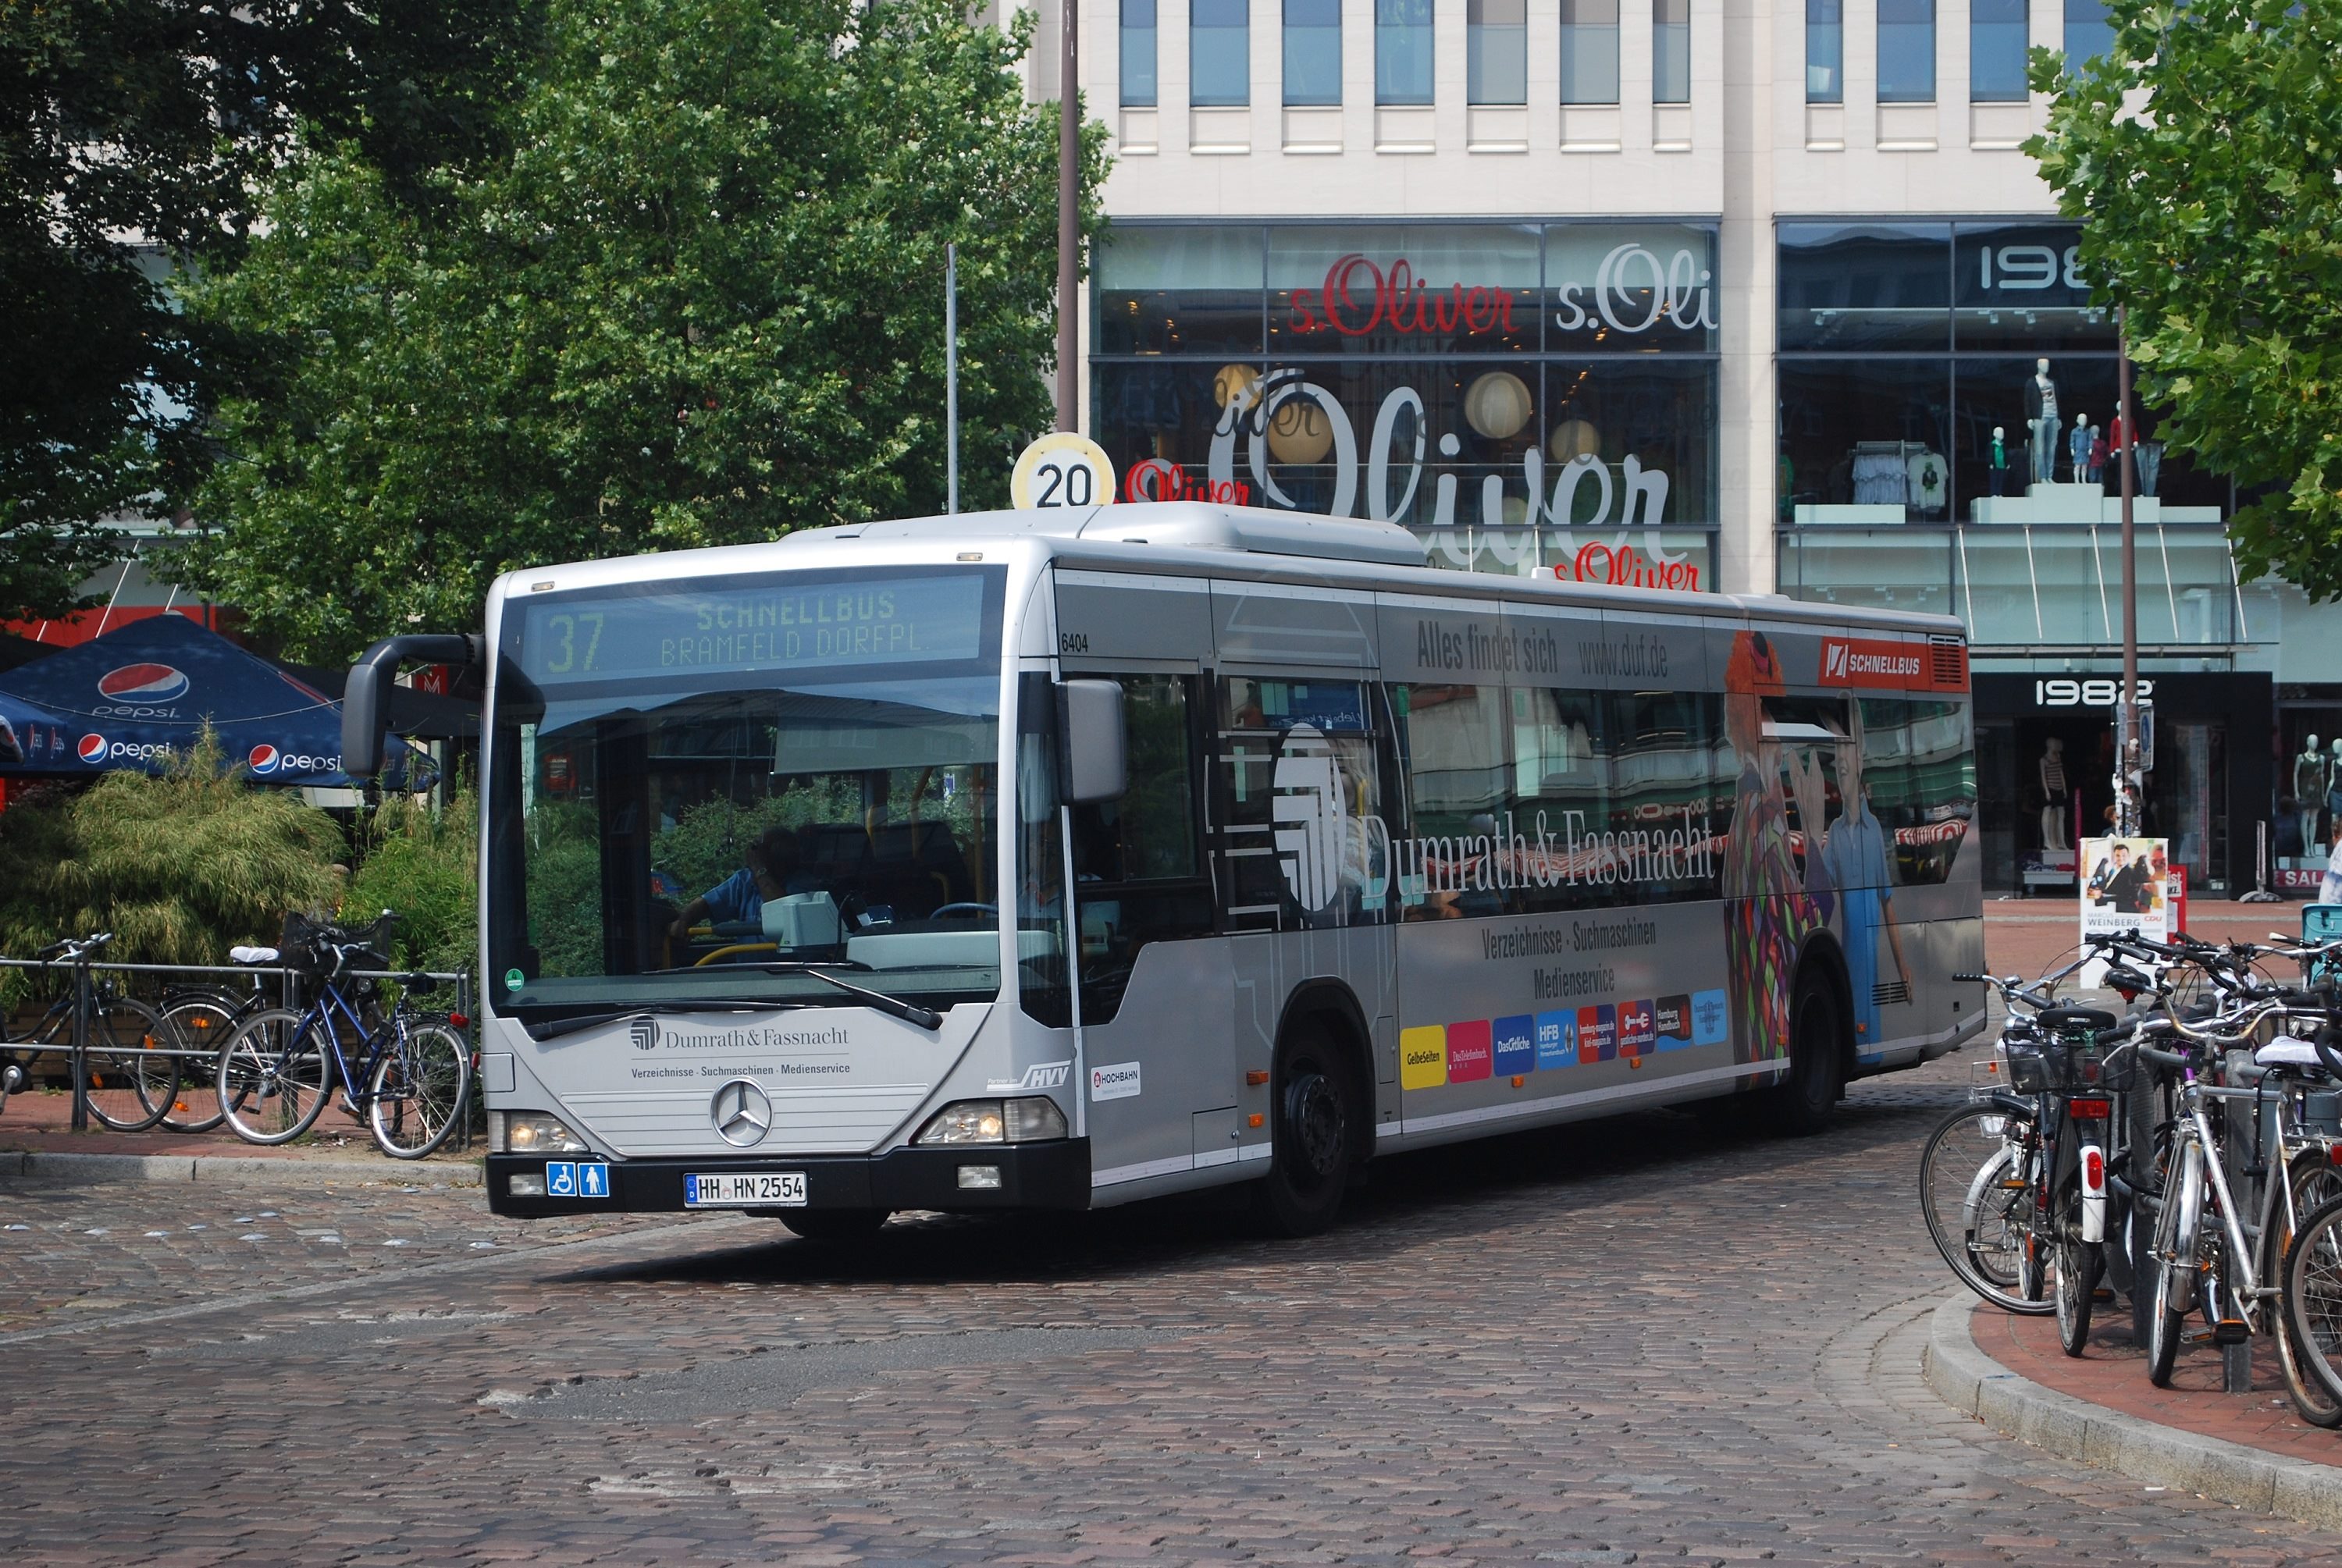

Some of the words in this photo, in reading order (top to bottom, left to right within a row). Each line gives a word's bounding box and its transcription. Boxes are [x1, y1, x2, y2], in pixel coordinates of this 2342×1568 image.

[1287, 253, 1520, 336] s.Oliver
[1132, 368, 1688, 568] Oliver
[1037, 464, 1091, 507] 20
[1114, 458, 1249, 507] Oliver
[1554, 541, 1704, 592] sOliver
[696, 592, 895, 631] SCHNELLBUS
[548, 613, 603, 673] 37
[661, 630, 800, 667] BRAMFELD
[1062, 633, 1088, 652] 6404
[1418, 620, 1462, 670] Alles
[1468, 624, 1519, 672] findet
[1523, 628, 1558, 674] sich
[1579, 633, 1668, 677] www.duf.de
[1849, 654, 1920, 675] SCHNELLBUS
[2036, 680, 2153, 705] 1982
[91, 706, 175, 718] pepsi
[110, 741, 171, 759] pepsi
[281, 754, 342, 773] pepsi
[2285, 870, 2326, 886] SAL
[2088, 918, 2141, 926] WEINBERG
[1482, 924, 1562, 960] Verzeichnisse
[1573, 916, 1656, 952] Suchmaschinen
[1534, 963, 1614, 999] Medienservice
[1539, 1024, 1559, 1042] HFB
[632, 1067, 694, 1079] Verzeichnisse
[701, 1065, 774, 1076] Suchmaschinen
[781, 1062, 850, 1075] Medienservice
[1030, 1066, 1070, 1087] HVV
[1102, 1070, 1138, 1085] HOCHBAHN
[699, 1178, 720, 1199] HH
[734, 1178, 755, 1198] HN
[760, 1177, 803, 1198] 2554
